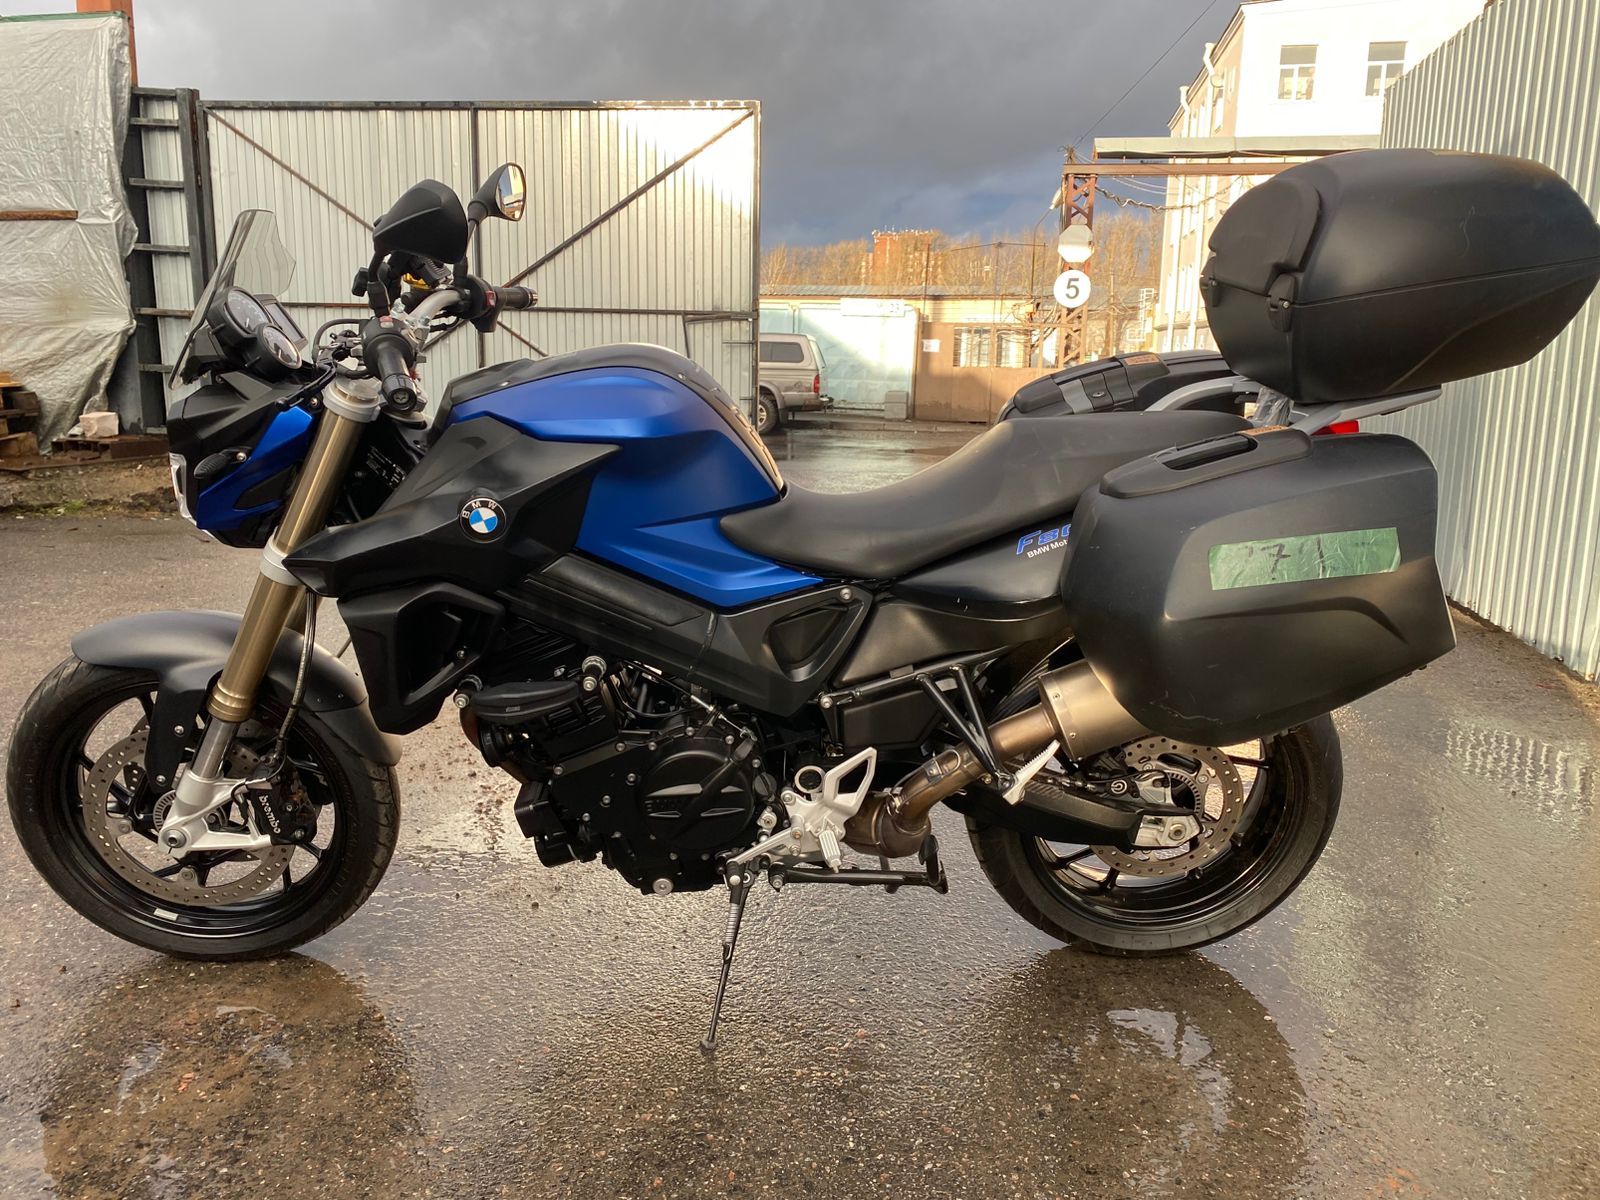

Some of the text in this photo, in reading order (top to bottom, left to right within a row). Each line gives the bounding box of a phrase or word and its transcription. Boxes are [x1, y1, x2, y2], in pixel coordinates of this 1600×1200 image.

[1065, 277, 1080, 300] 5
[461, 500, 497, 519] BMW
[1026, 543, 1050, 559] BMW
[258, 794, 281, 834] brembo
